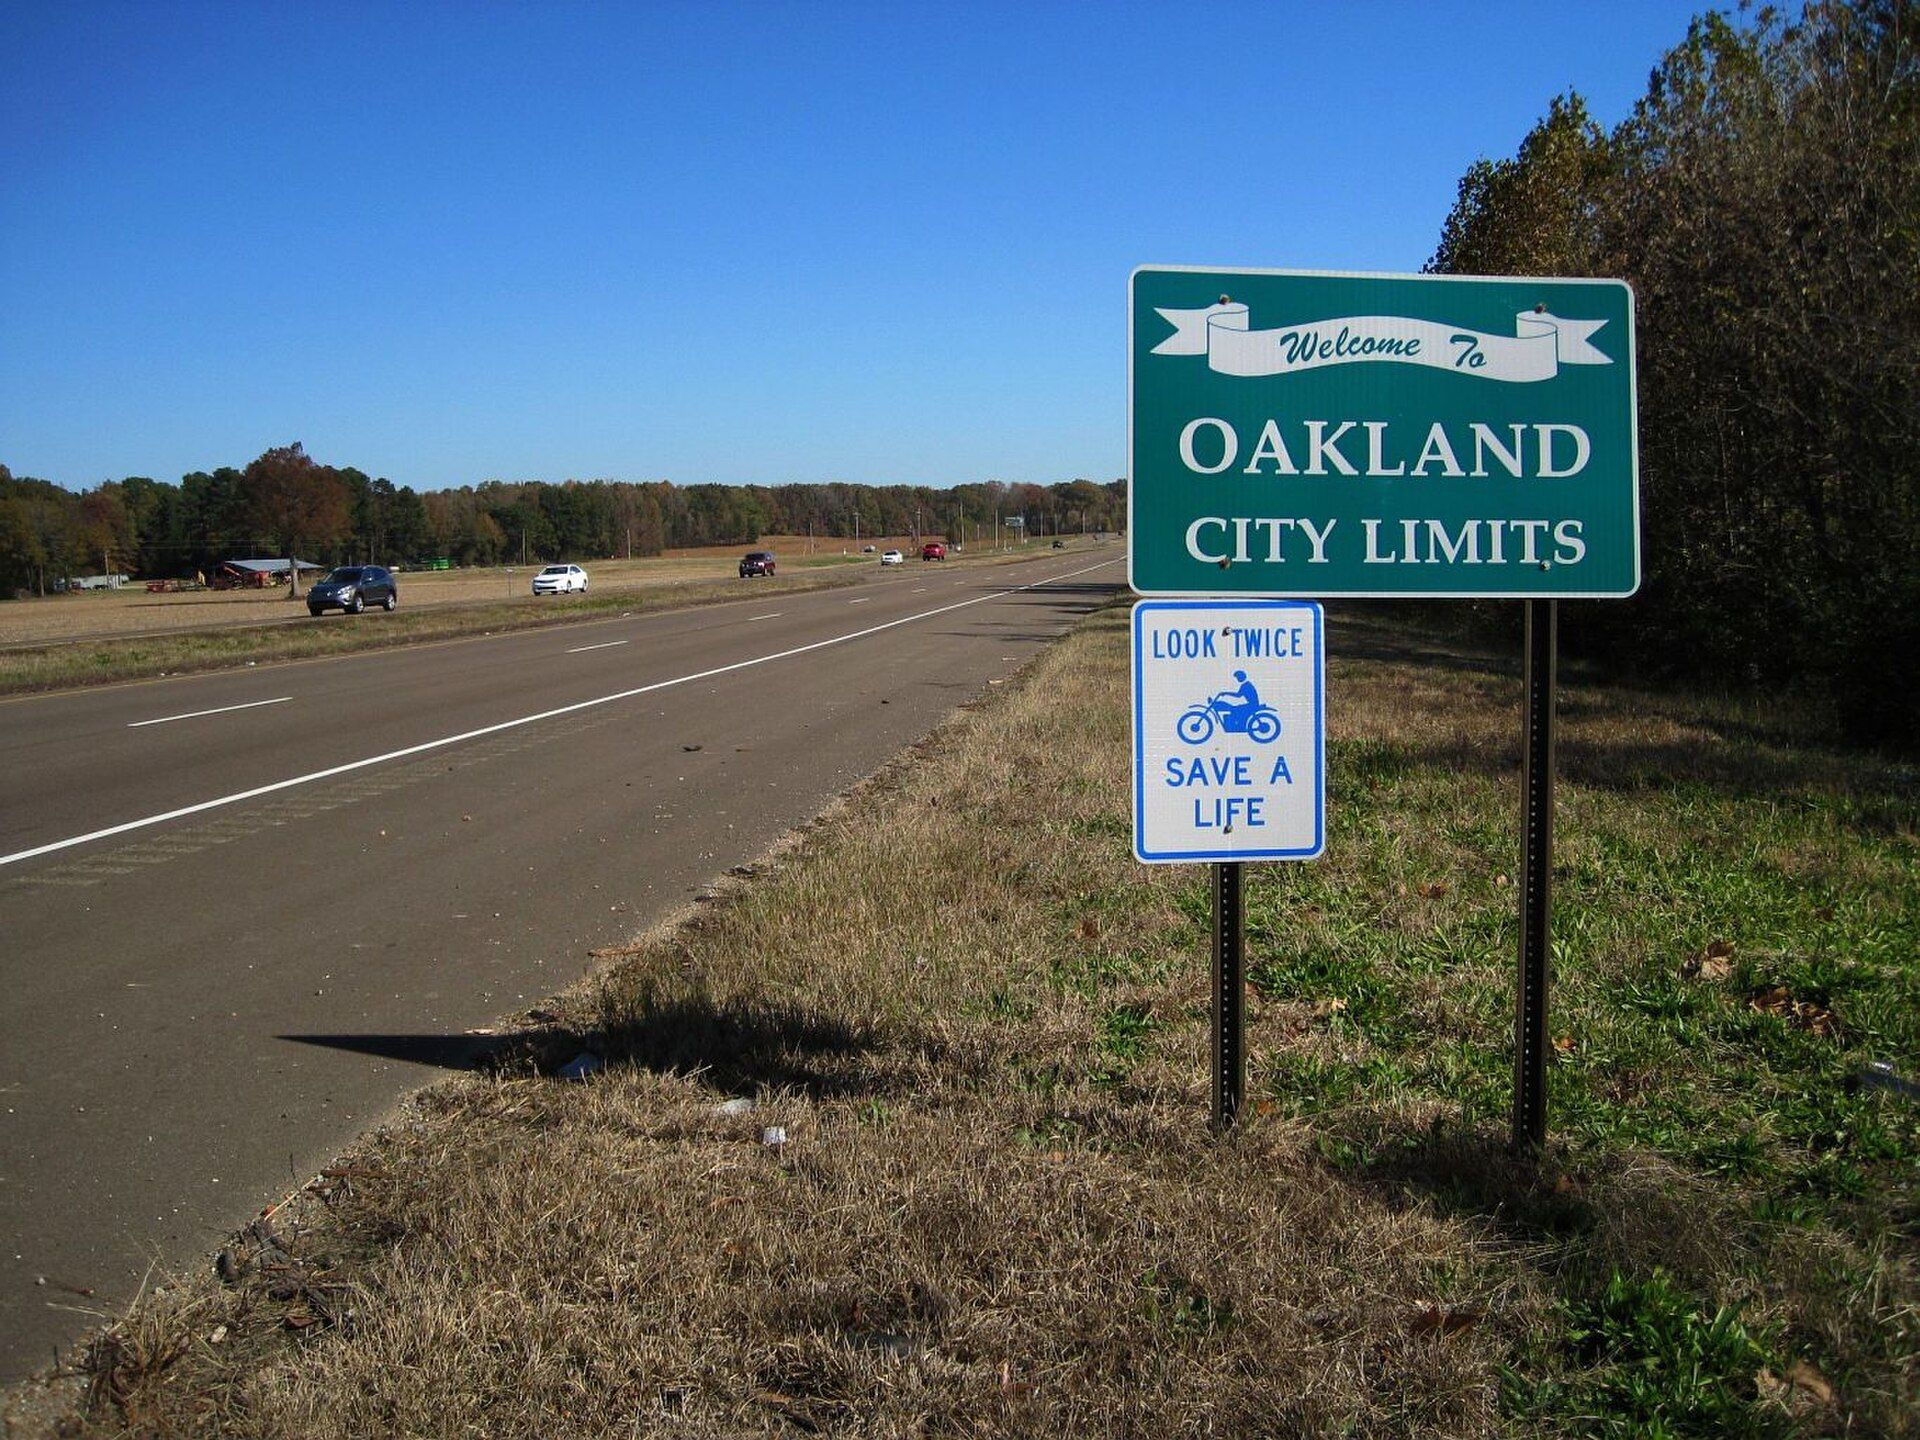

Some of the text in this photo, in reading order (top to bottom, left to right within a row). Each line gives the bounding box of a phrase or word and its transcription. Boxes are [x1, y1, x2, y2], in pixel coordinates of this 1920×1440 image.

[1279, 326, 1488, 368] Welcome To
[1178, 416, 1591, 478] OAKLAND
[1184, 516, 1587, 565] CITY LIMITS
[1153, 627, 1304, 659] LOOK TWICE
[1165, 755, 1293, 787] SAVE A
[1194, 797, 1266, 828] LIFE
